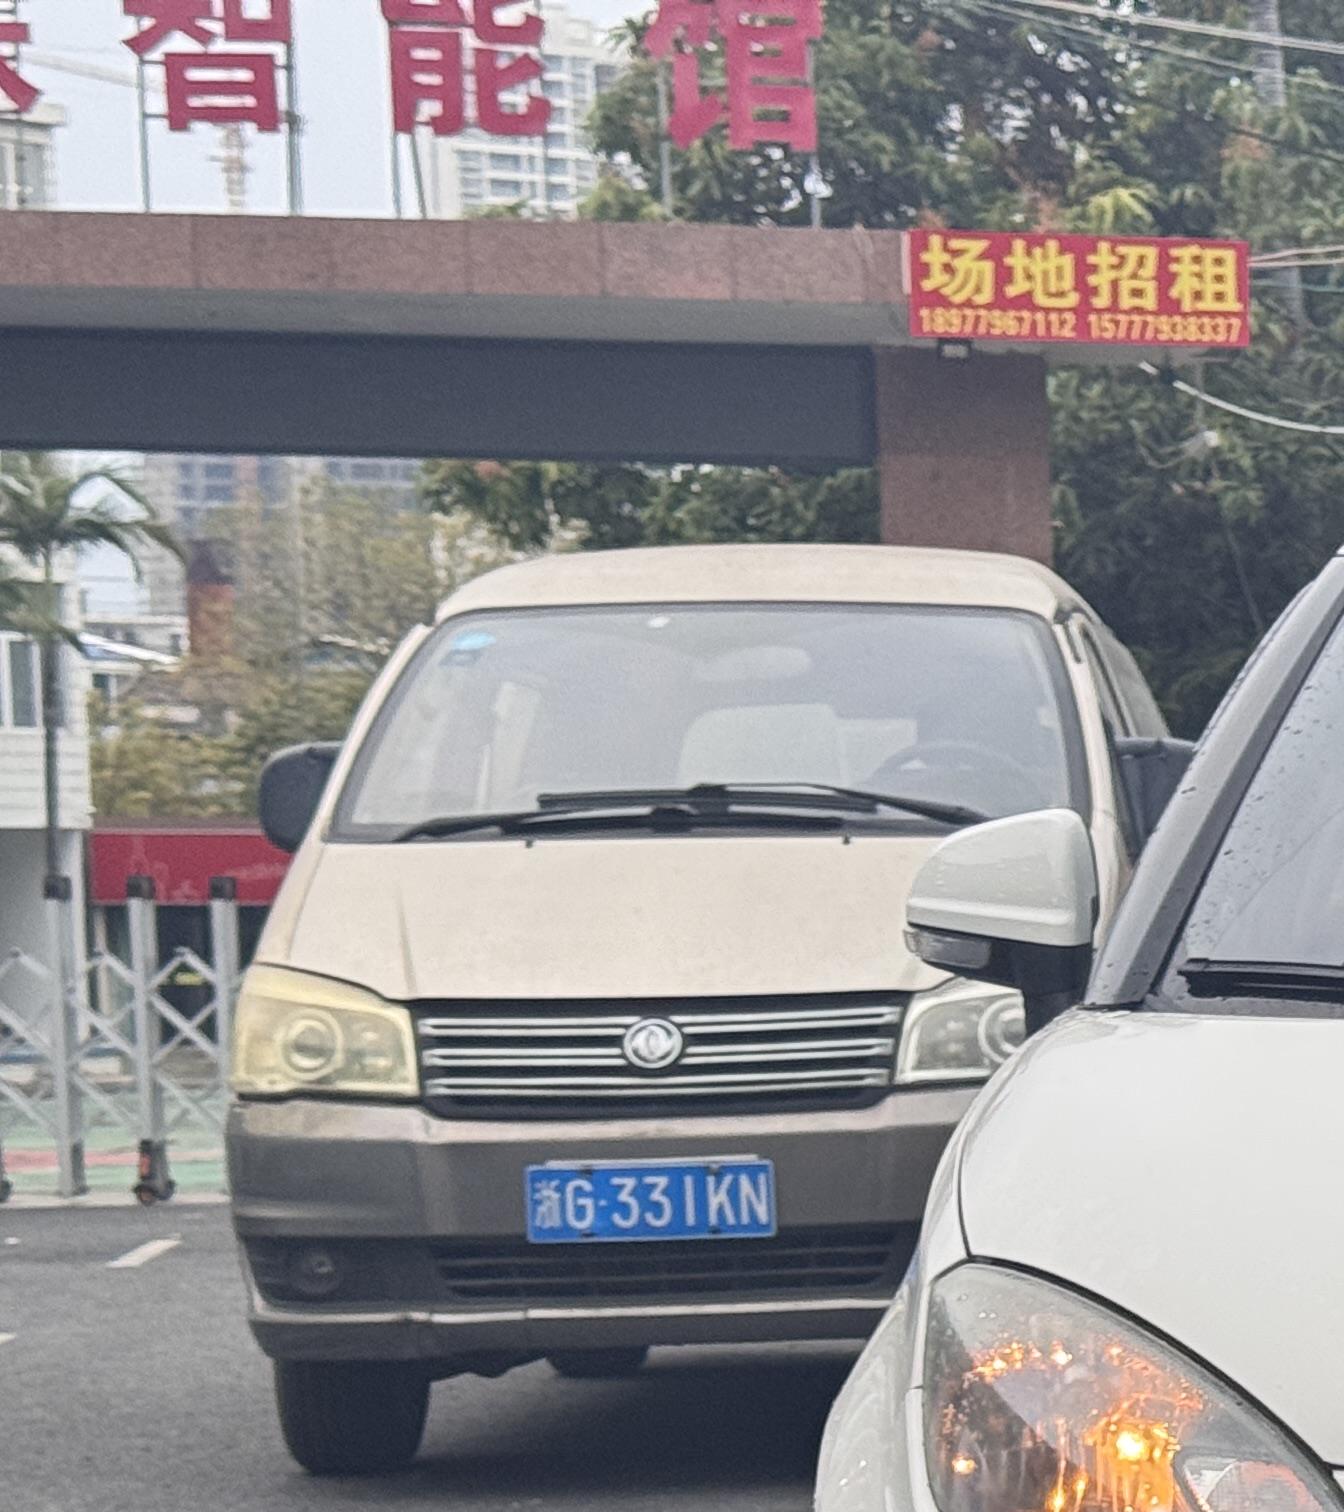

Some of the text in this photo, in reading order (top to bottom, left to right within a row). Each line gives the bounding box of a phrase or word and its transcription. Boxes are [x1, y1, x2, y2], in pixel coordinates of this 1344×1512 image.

[0, 0, 823, 151] 智能馆
[919, 234, 1245, 313] 场地招租
